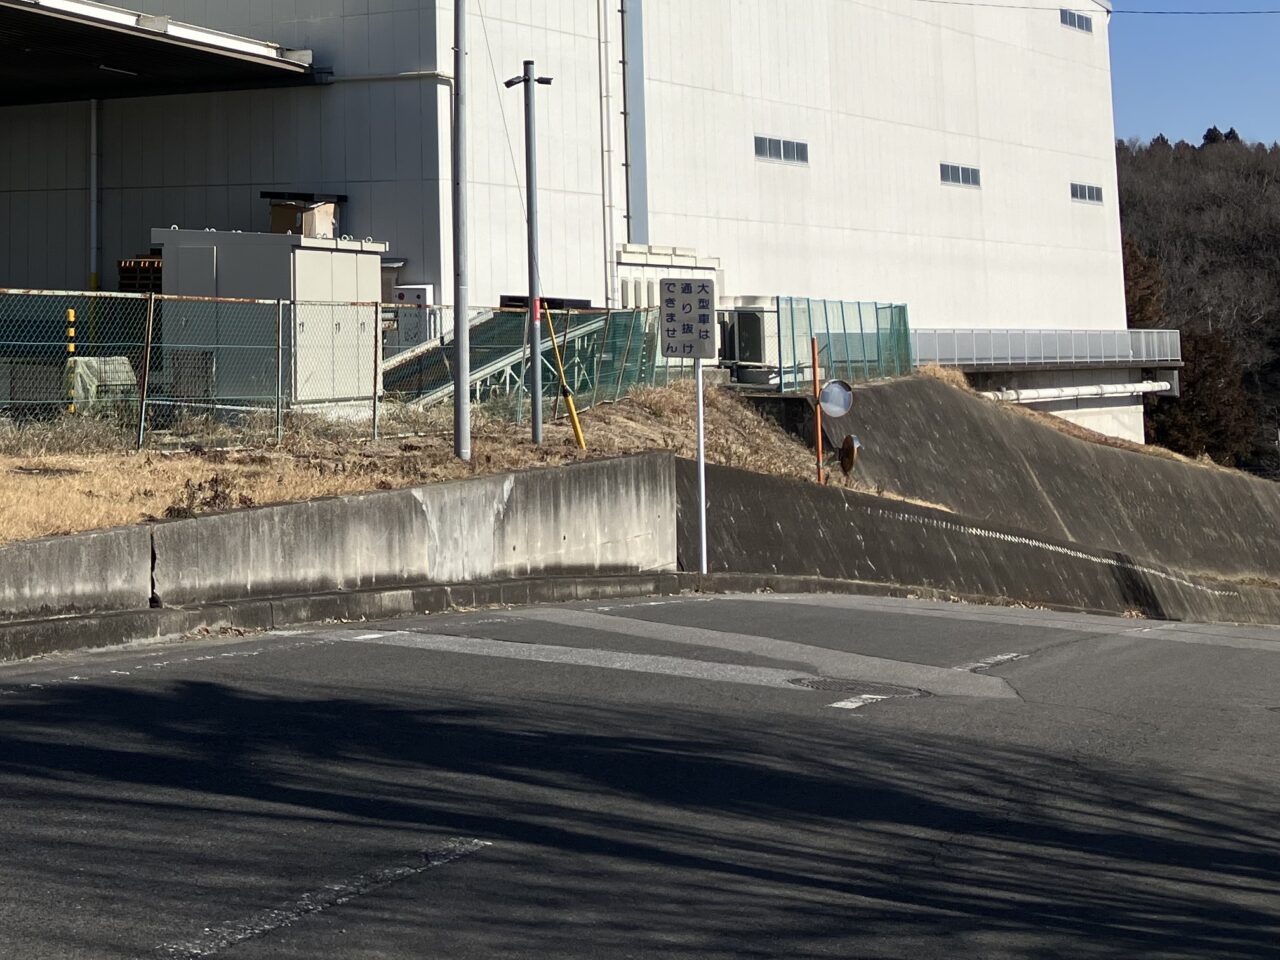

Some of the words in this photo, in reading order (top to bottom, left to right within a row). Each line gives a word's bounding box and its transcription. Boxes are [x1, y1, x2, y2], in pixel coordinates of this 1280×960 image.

[664, 283, 678, 353] できません
[681, 283, 694, 354] 通り抜け
[697, 283, 710, 340] 大型車は
